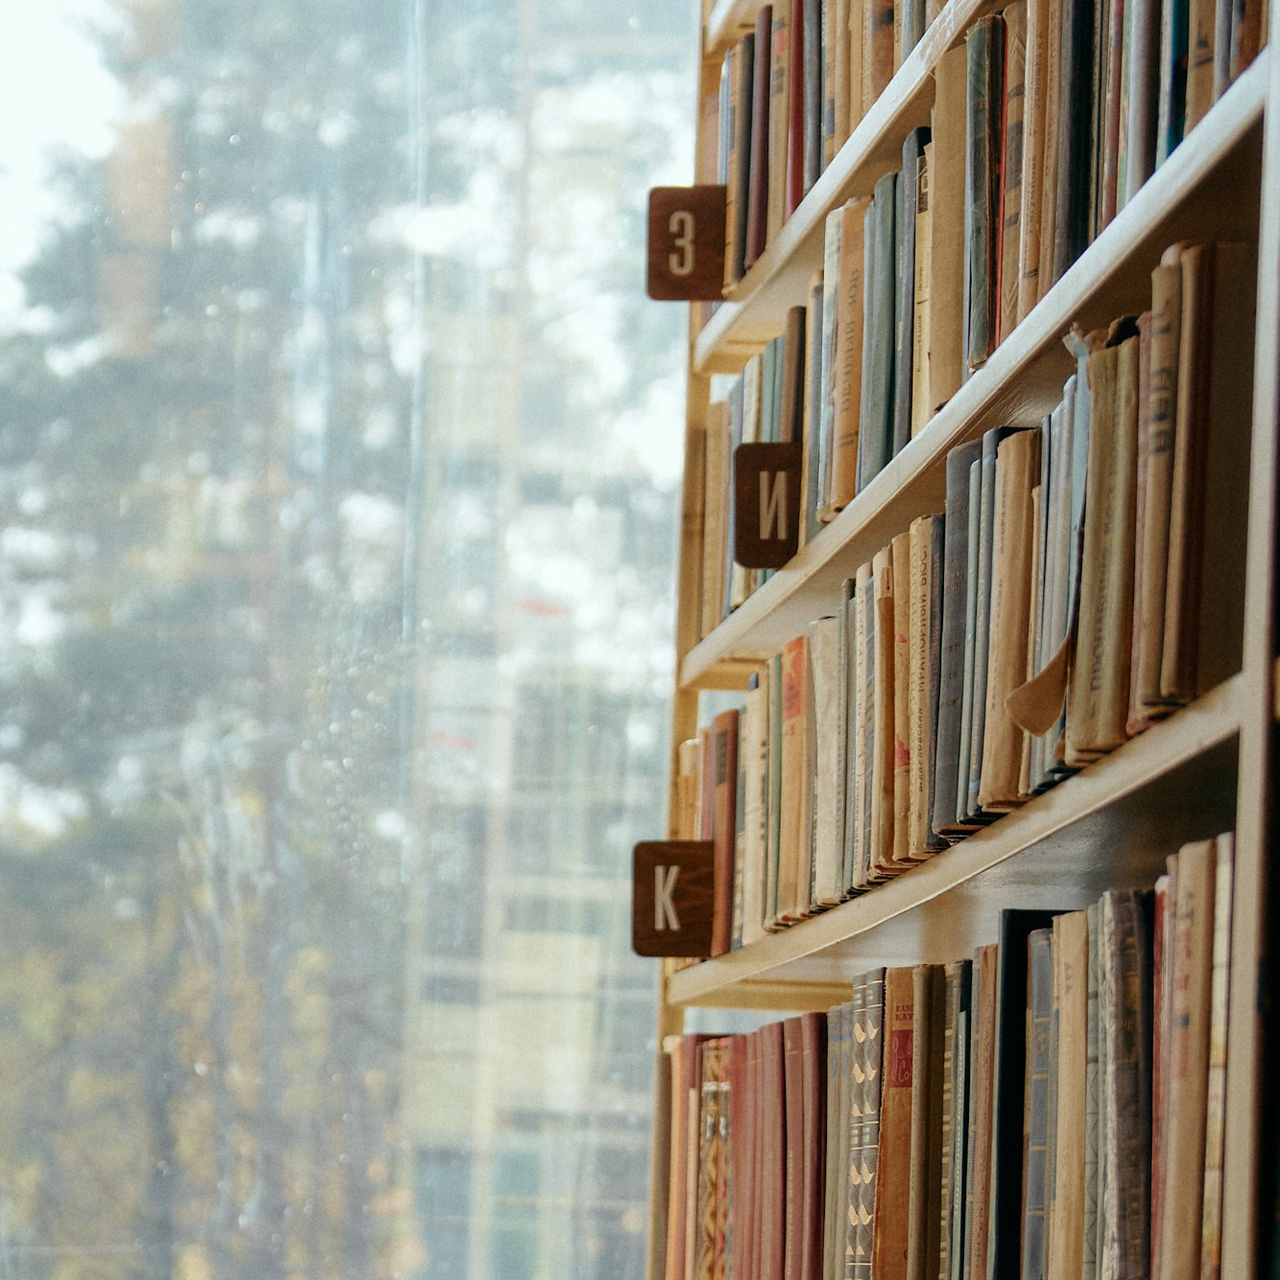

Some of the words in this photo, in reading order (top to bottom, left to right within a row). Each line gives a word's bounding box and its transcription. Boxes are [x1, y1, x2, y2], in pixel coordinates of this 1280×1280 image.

[841, 320, 855, 412] ВЕЧНЫЙ
[848, 267, 858, 310] ЗОВ
[759, 471, 788, 541] И
[917, 593, 928, 692] МРАМОРНЫЙ
[654, 865, 681, 932] К
